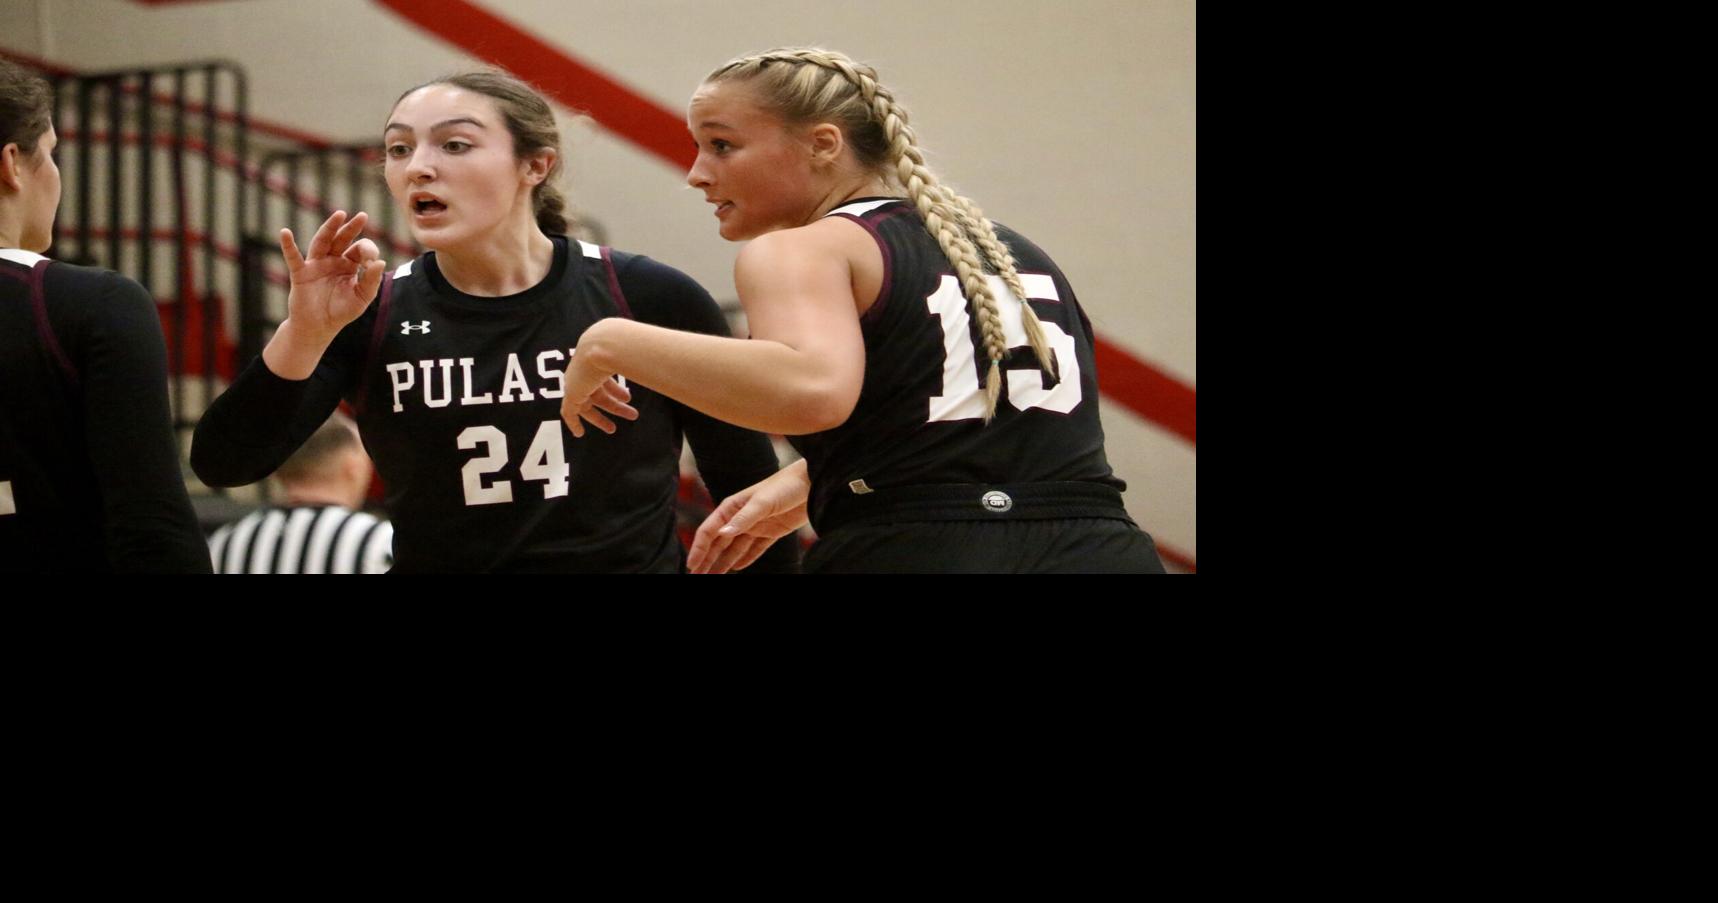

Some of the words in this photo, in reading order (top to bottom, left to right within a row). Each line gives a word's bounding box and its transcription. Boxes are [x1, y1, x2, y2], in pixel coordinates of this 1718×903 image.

[386, 348, 629, 412] PULAS
[926, 273, 1082, 423] 15
[456, 419, 569, 506] 24
